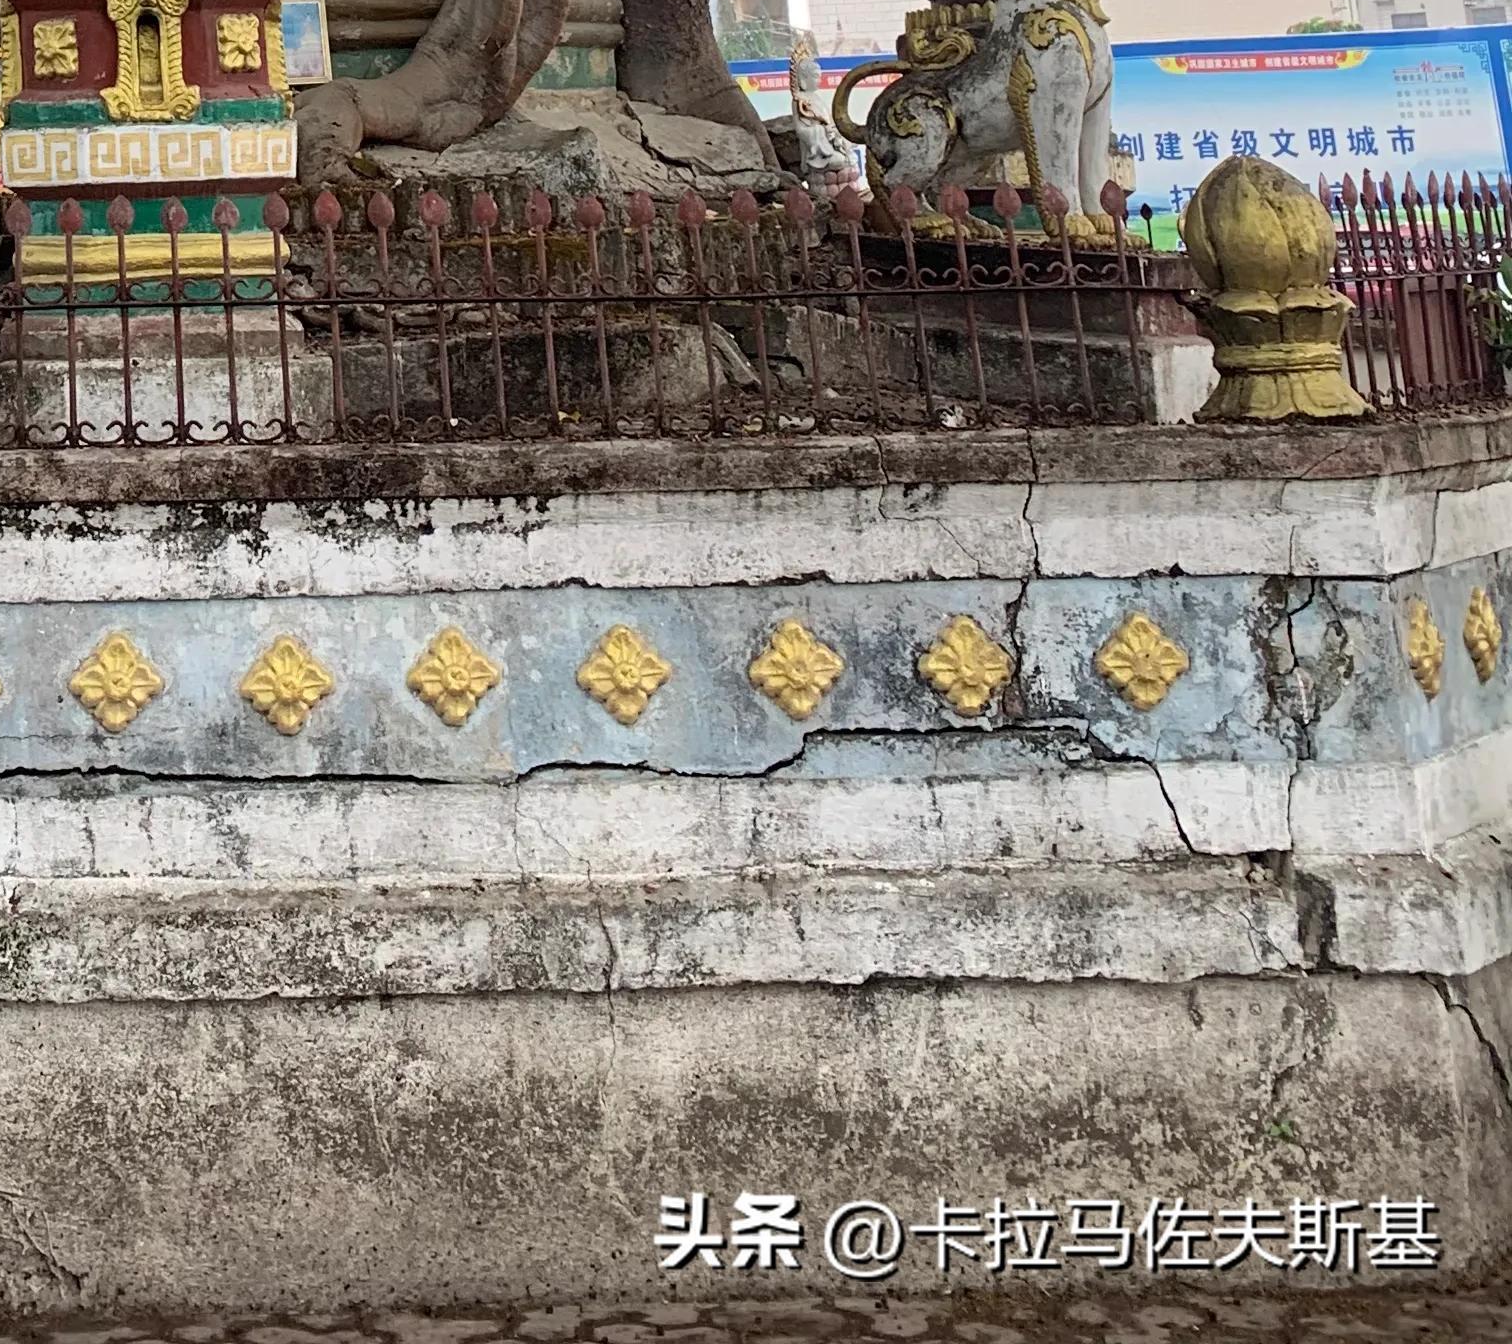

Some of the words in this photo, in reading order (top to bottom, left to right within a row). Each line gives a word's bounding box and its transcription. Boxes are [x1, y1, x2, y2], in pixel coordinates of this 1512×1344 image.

[1117, 124, 1416, 162] 创建省级文明城市
